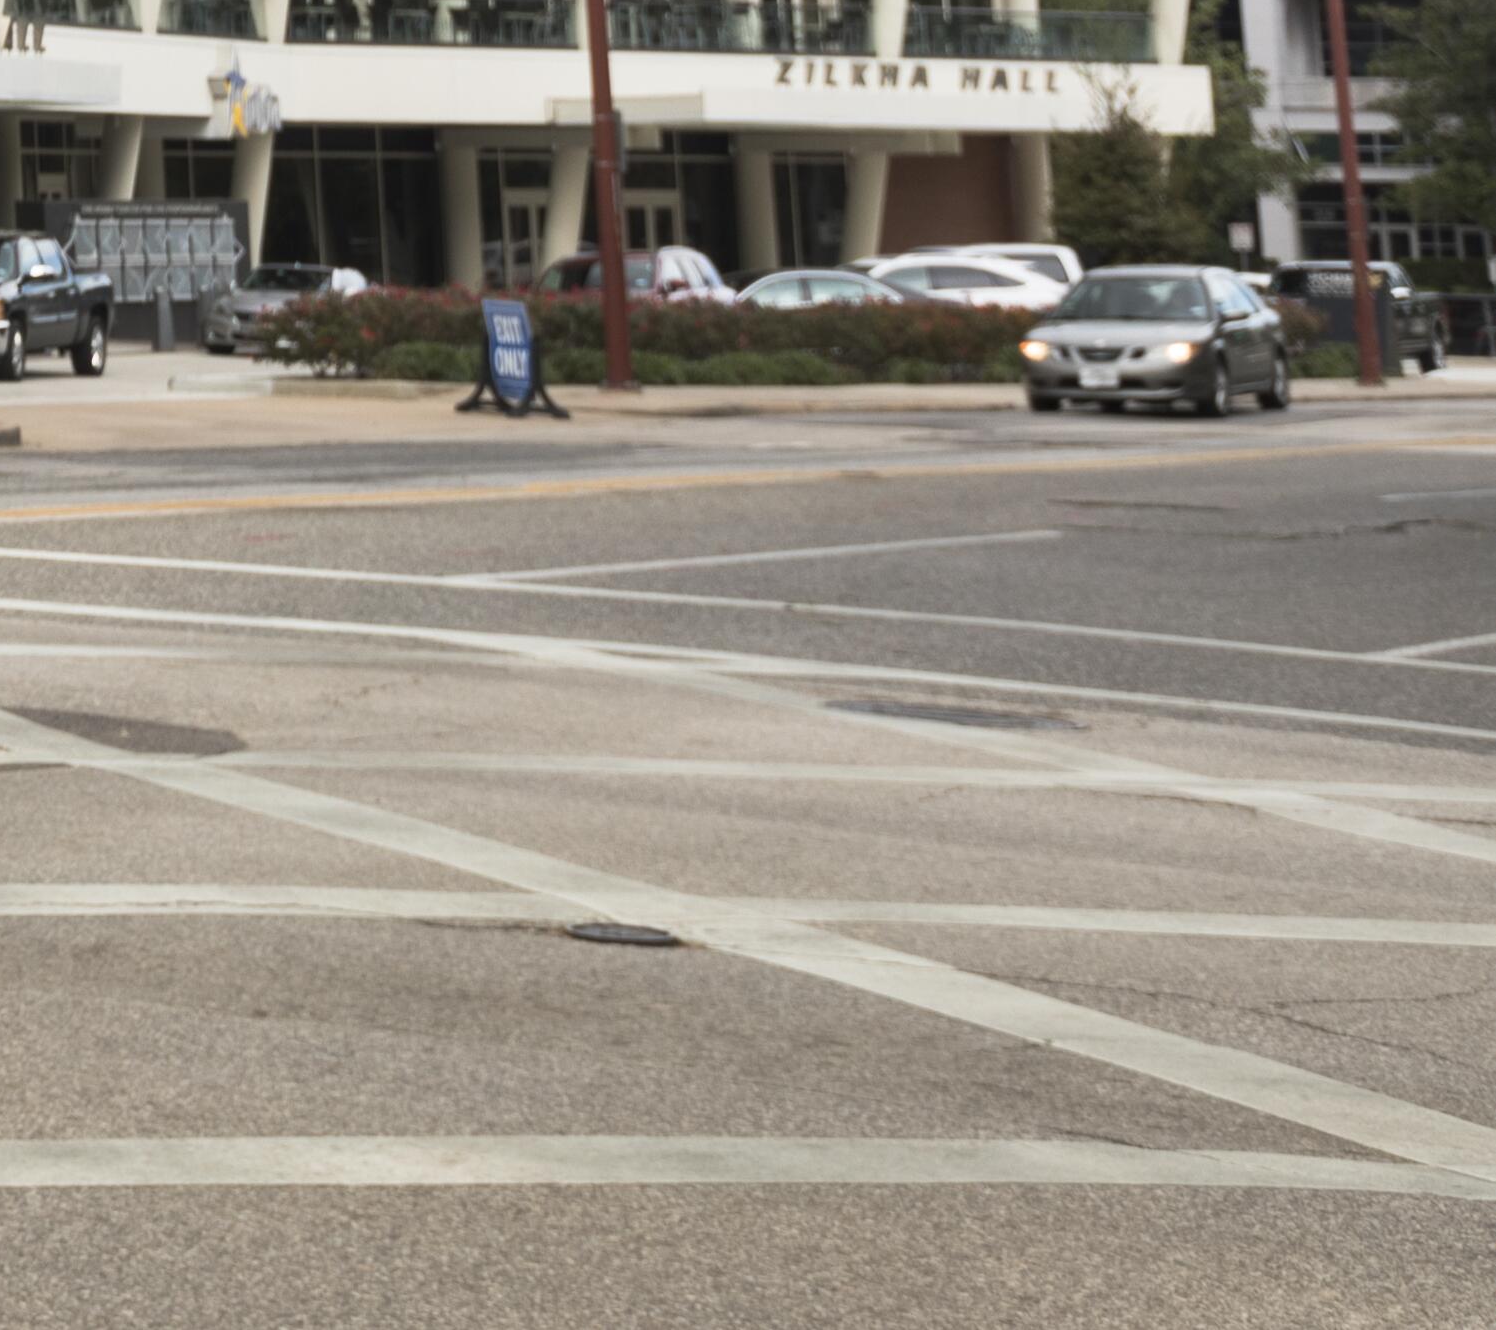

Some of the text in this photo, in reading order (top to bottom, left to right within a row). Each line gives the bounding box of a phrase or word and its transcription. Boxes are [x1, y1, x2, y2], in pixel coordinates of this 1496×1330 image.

[775, 56, 1059, 92] ZILKHA HALL
[493, 315, 521, 344] EXIT
[494, 347, 527, 378] ONLY
